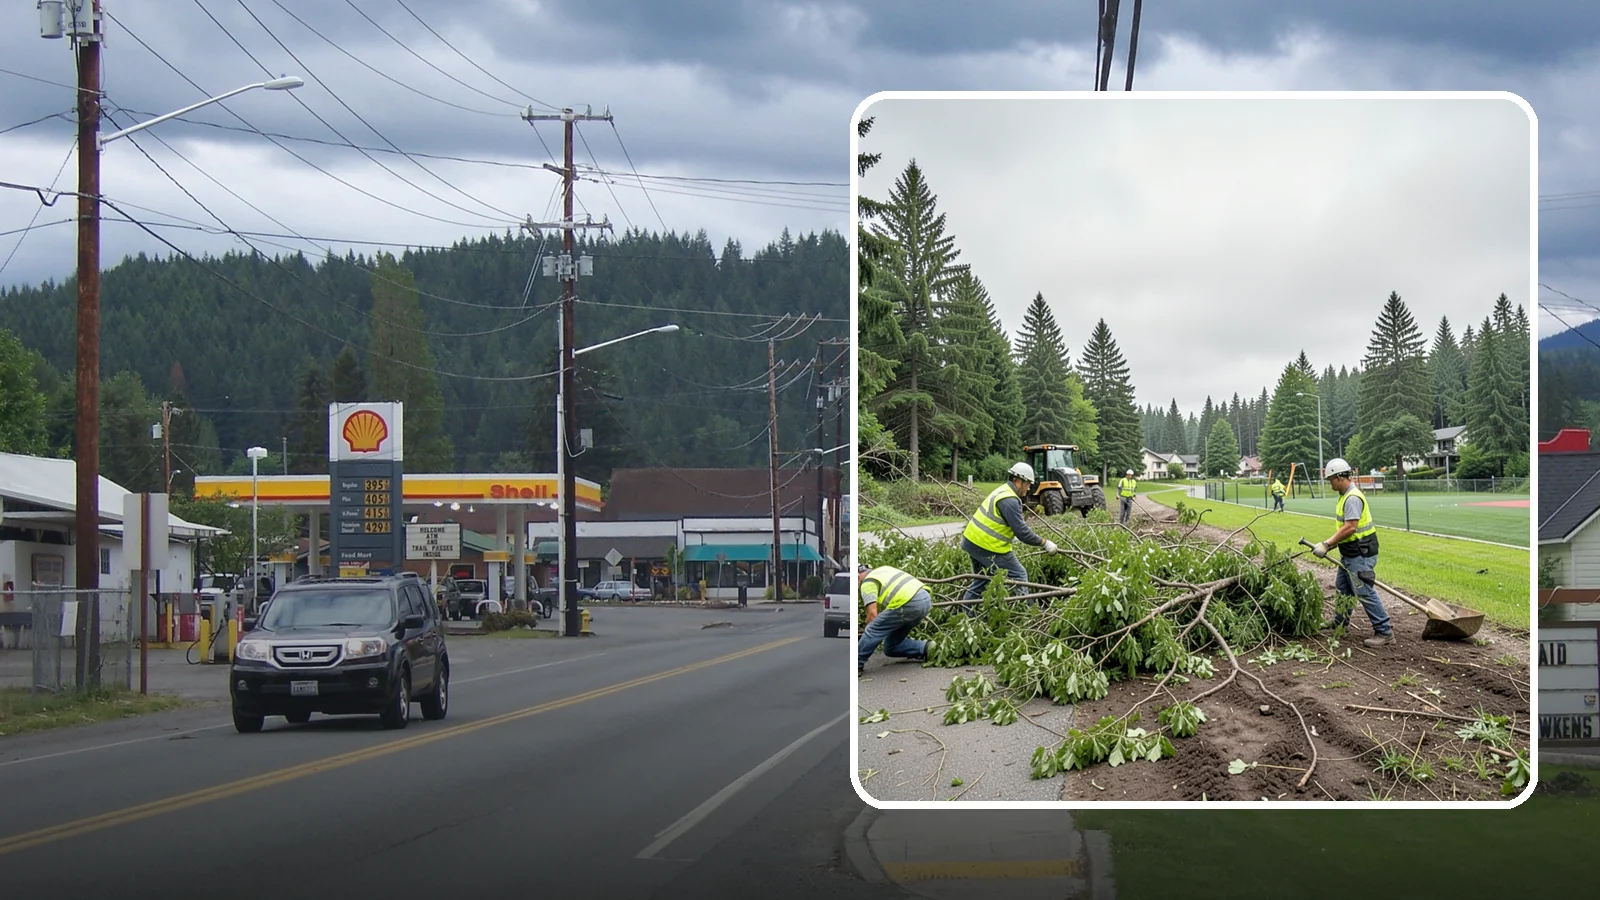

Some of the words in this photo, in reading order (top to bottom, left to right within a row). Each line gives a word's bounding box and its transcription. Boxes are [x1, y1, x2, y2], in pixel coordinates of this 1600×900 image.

[365, 479, 384, 490] 395
[490, 484, 547, 499] Shell
[365, 494, 384, 504] 405
[365, 508, 384, 518] 415
[365, 522, 384, 532] 429
